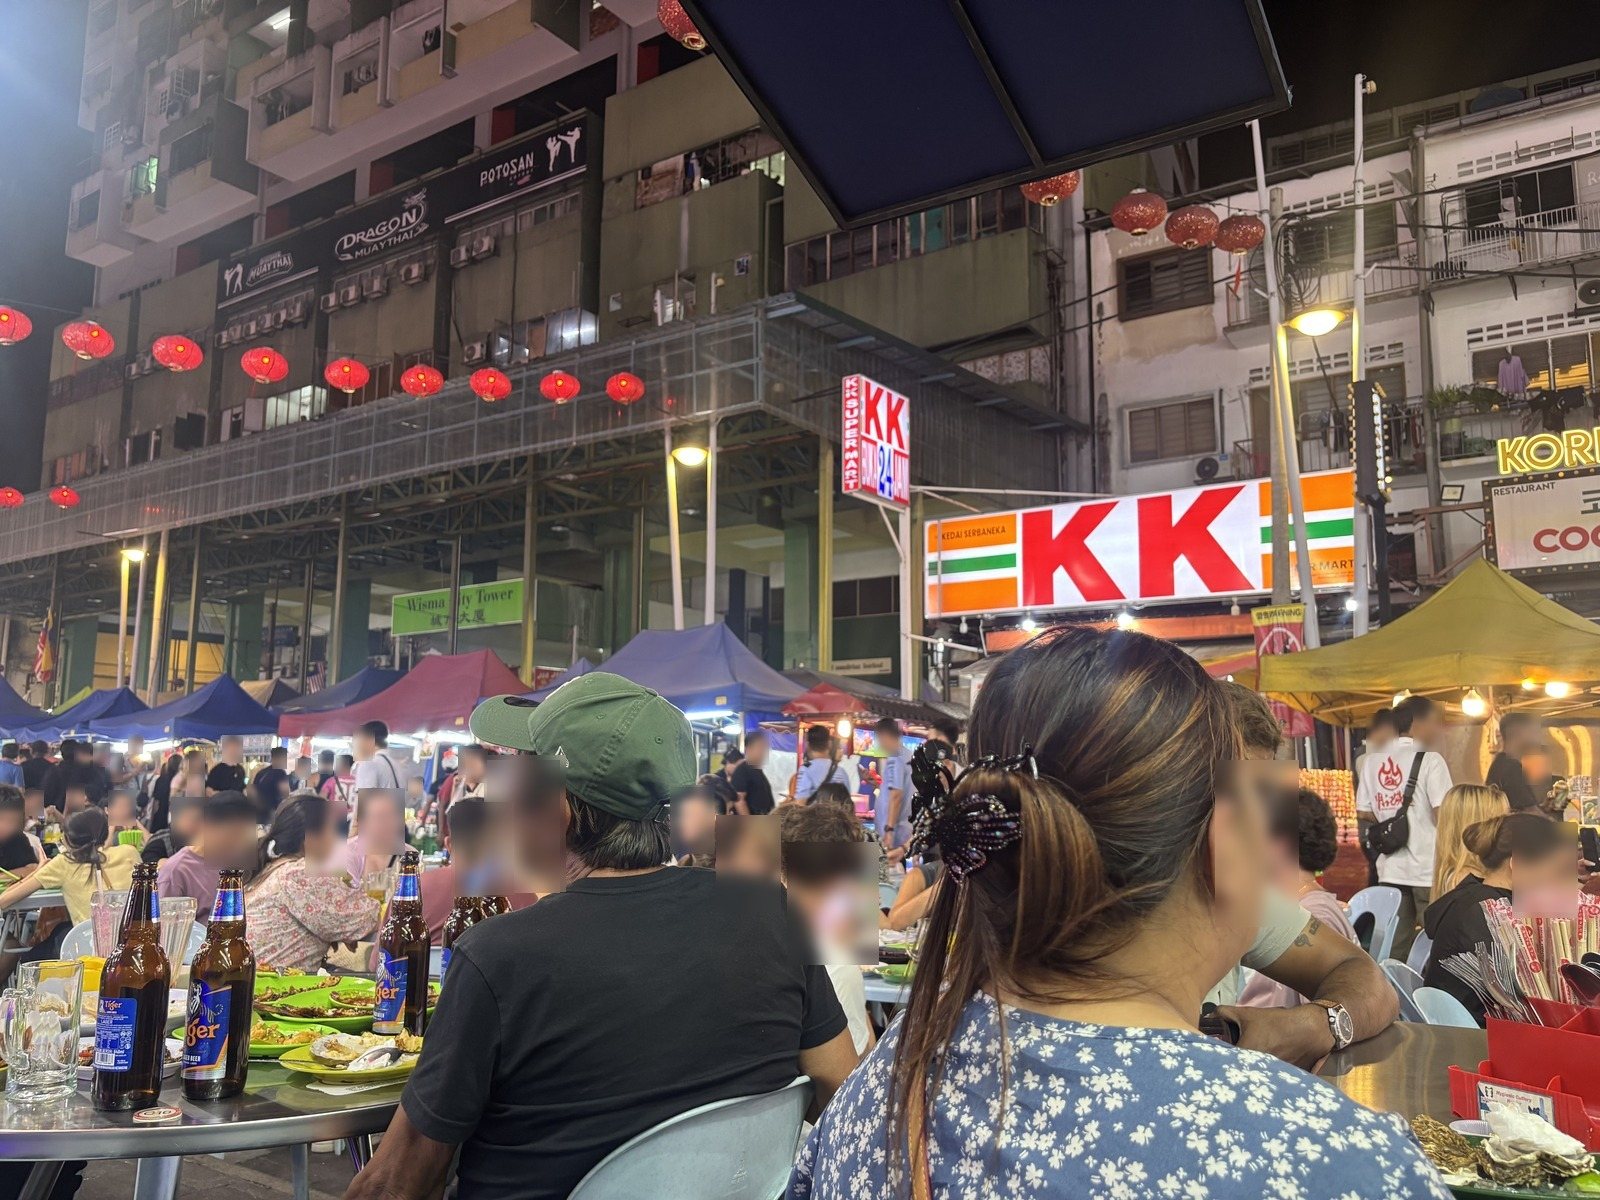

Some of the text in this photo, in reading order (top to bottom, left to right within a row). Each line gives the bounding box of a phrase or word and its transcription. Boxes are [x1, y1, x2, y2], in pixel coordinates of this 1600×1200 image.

[480, 152, 534, 187] POTOSAN
[342, 208, 417, 250] DRAGON
[865, 381, 905, 450] KK
[878, 445, 893, 497] 24
[1493, 482, 1556, 497] RESTAURANT
[942, 525, 1006, 540] KEDAI SERBANEKA
[1022, 485, 1256, 606] KK
[407, 598, 445, 612] Wisma
[476, 589, 514, 604] Tower
[104, 1000, 123, 1010] Tiger
[186, 1017, 220, 1047] ger
